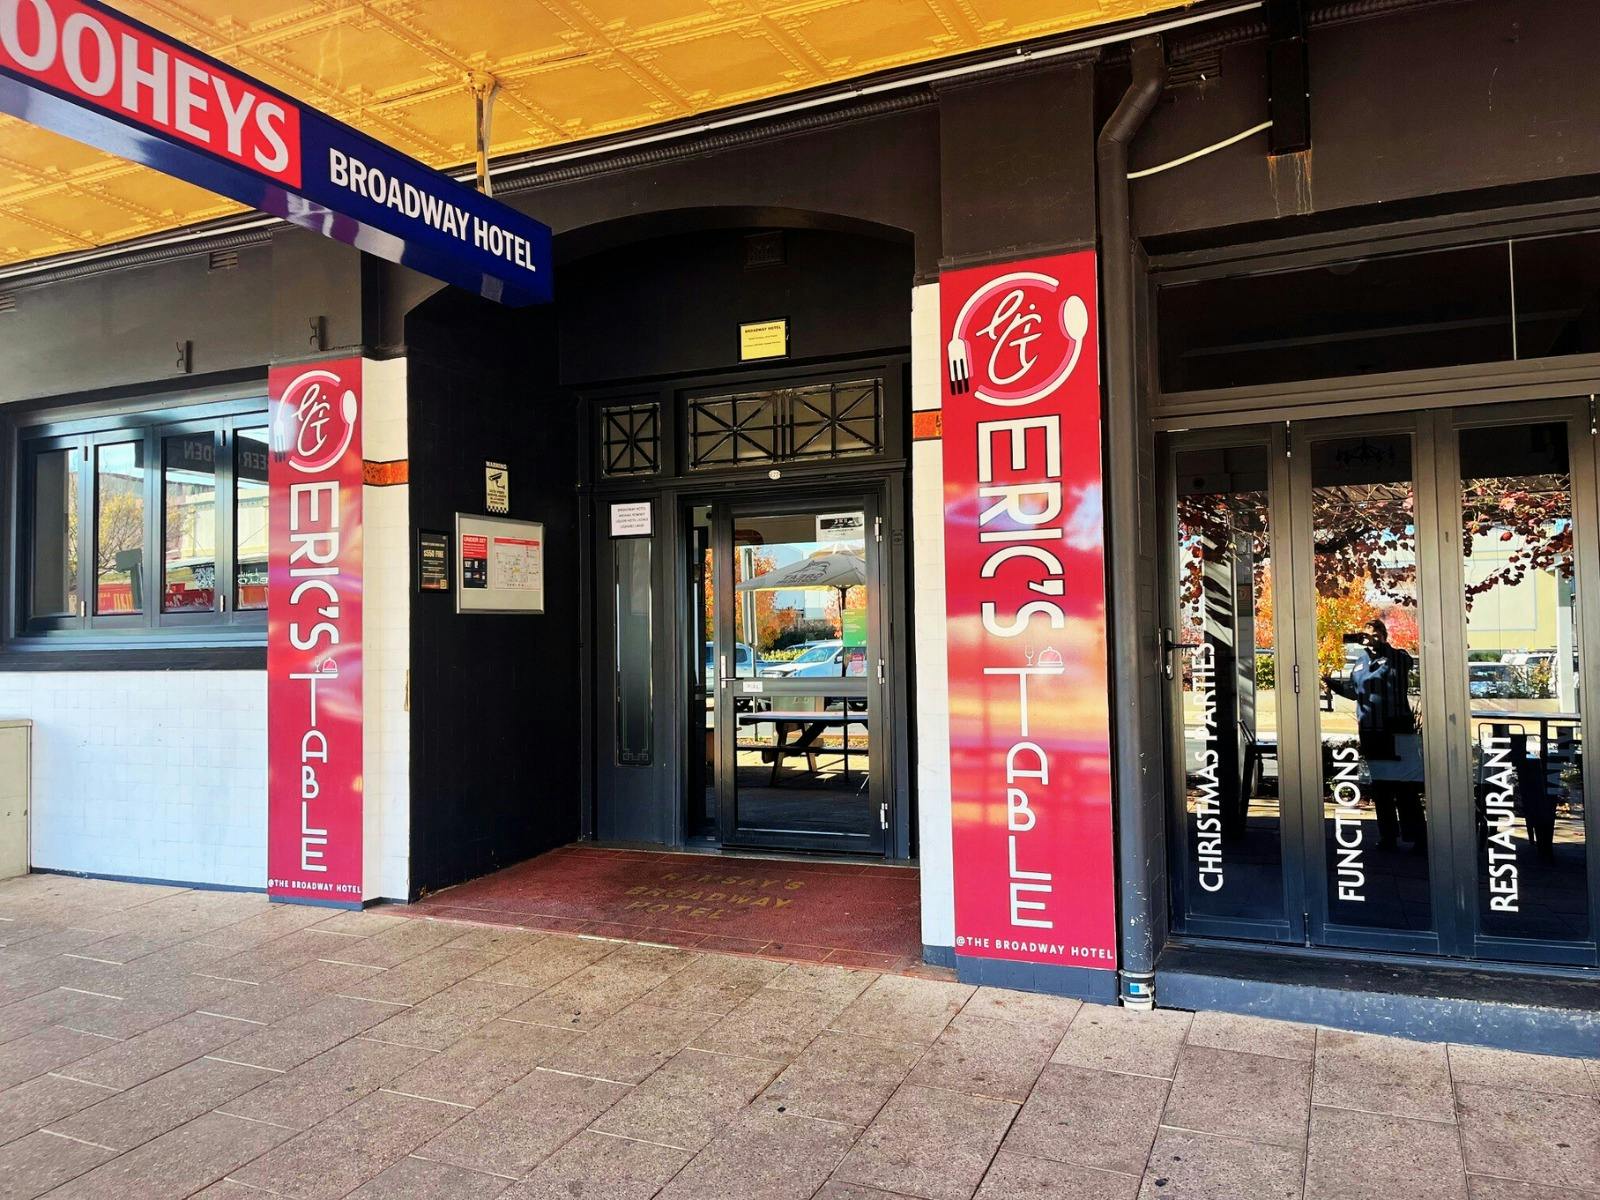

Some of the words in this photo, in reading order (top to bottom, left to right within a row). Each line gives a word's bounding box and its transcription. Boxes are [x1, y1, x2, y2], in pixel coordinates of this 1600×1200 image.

[329, 147, 470, 242] BROADWAY
[473, 216, 536, 272] HOTEL
[289, 480, 340, 651] ERIC'S
[976, 413, 1065, 638] ERIC'S
[1191, 642, 1217, 741] PARTIES
[289, 673, 339, 872] TABLE
[983, 666, 1066, 929] TABLE
[1195, 749, 1224, 892] CHRISTMAS
[1333, 747, 1366, 902] FUNCTIONS
[1485, 736, 1519, 912] RESTAURANT
[268, 878, 289, 889] @THE
[291, 880, 334, 891] BROADWAY
[336, 884, 362, 894] HOTEL
[956, 935, 990, 948] @THE
[995, 939, 1065, 955] BROADWAY
[1071, 946, 1114, 960] HOTEL
